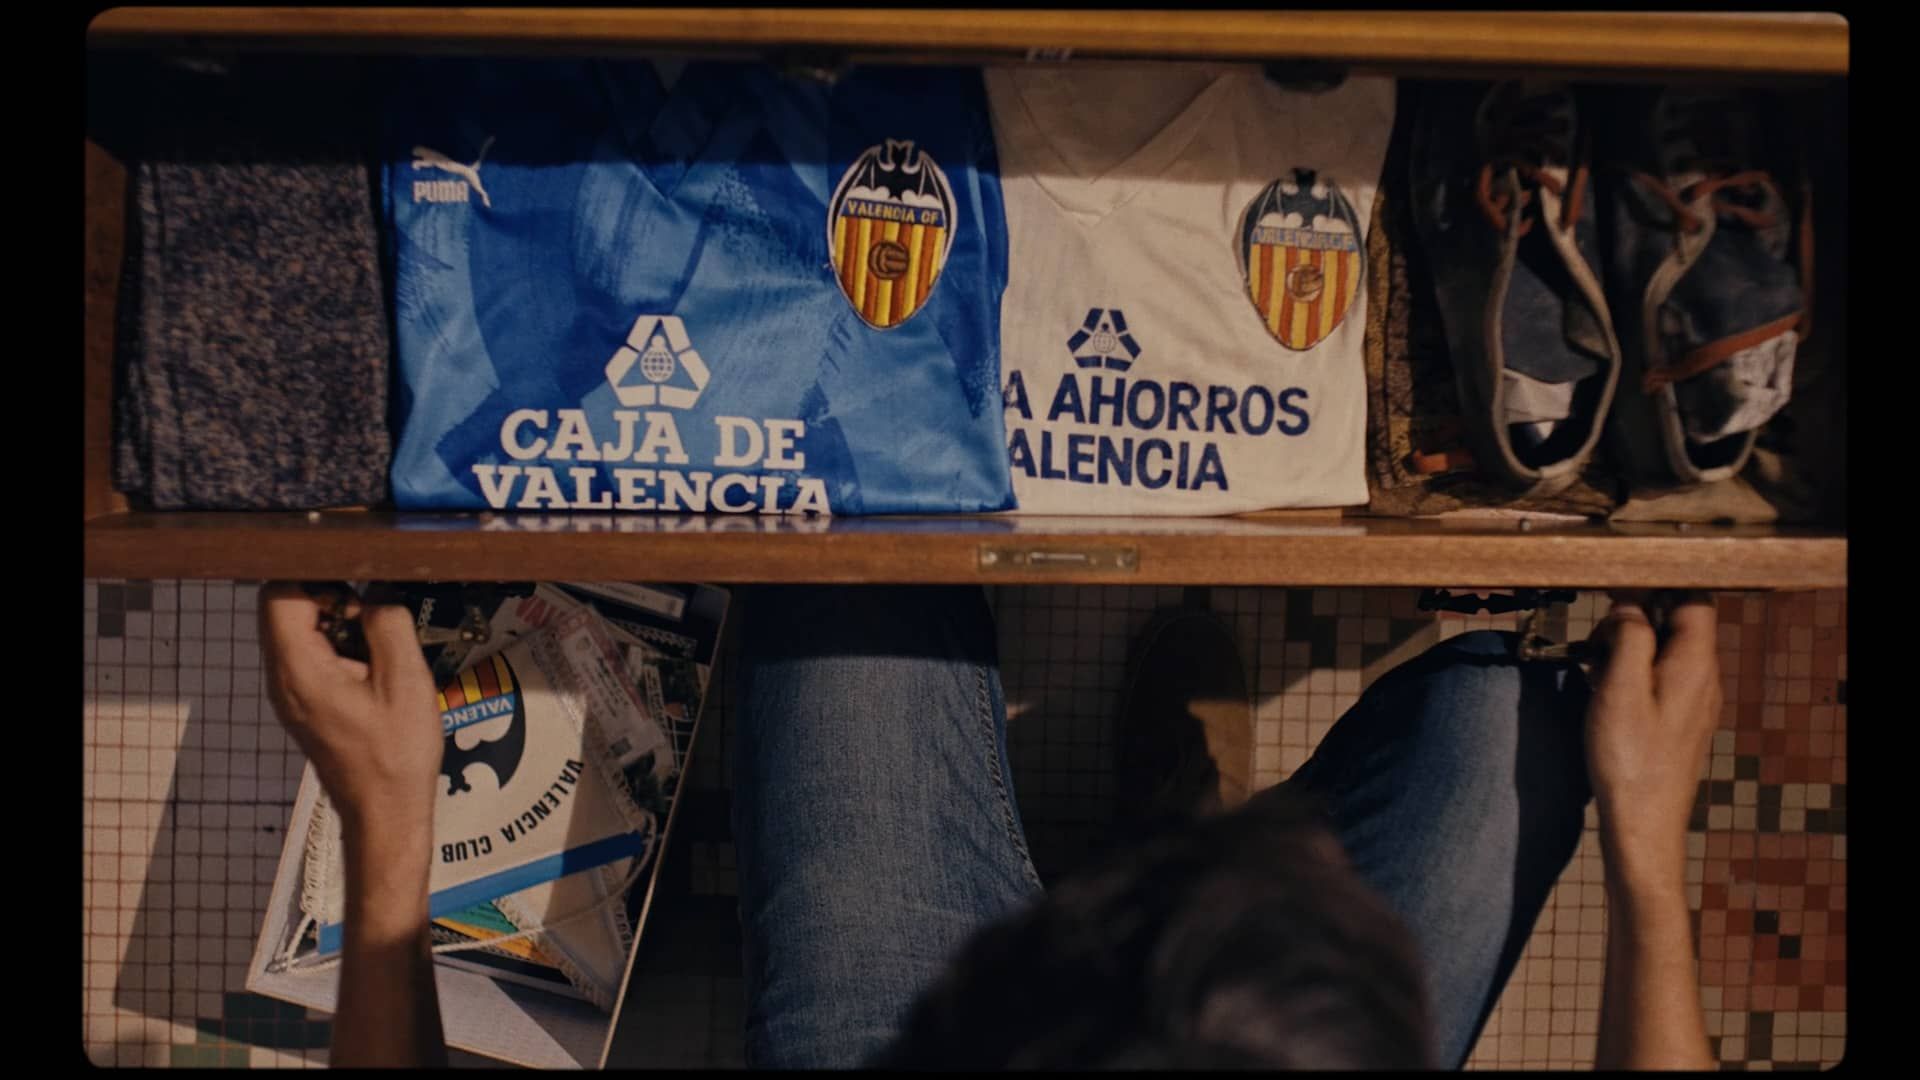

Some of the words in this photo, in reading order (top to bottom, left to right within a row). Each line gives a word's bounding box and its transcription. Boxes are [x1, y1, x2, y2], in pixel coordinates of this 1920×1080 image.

[413, 181, 470, 203] PUMA
[847, 200, 915, 223] VALENCIA
[921, 210, 939, 225] CF
[1004, 370, 1033, 420] A
[1048, 373, 1310, 436] AHORROS
[500, 409, 690, 465] CAJA
[715, 416, 806, 470] DE
[1008, 428, 1229, 491] ALENCIA
[472, 464, 831, 517] VALENCIA
[443, 697, 512, 732] VALENC
[500, 758, 584, 844] VALENCIA
[441, 835, 493, 863] CLUB
